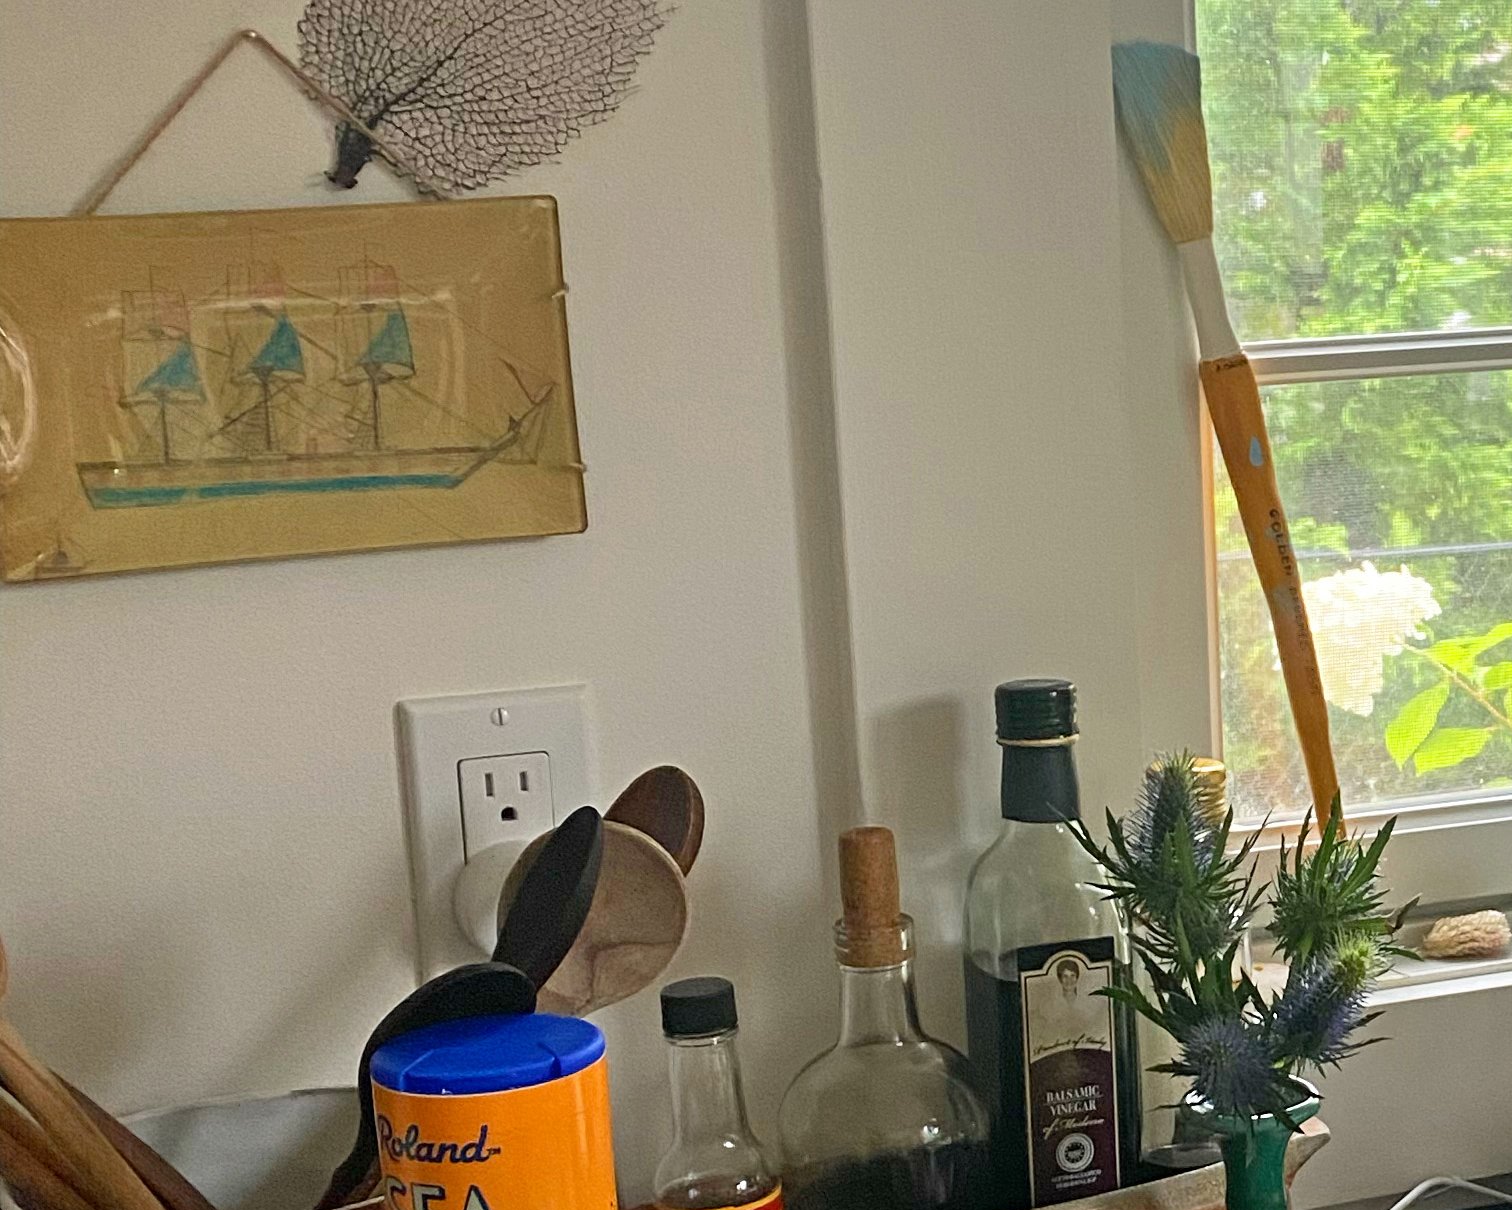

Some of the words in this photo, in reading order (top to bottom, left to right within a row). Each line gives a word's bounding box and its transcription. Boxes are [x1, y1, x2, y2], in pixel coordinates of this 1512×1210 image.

[1046, 1084, 1101, 1103] BALSAMIC
[1050, 1100, 1097, 1116] VINEGAR
[378, 1112, 490, 1164] Roland
